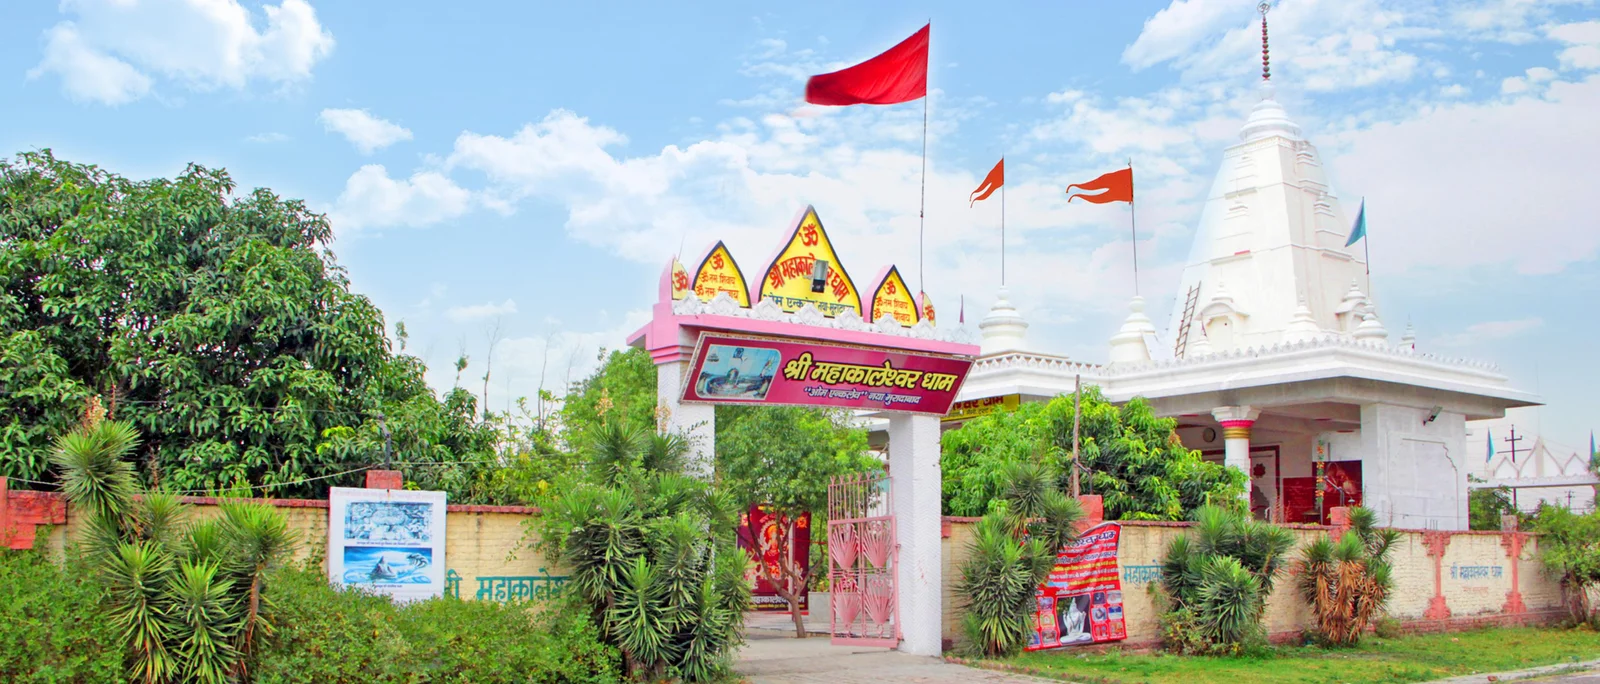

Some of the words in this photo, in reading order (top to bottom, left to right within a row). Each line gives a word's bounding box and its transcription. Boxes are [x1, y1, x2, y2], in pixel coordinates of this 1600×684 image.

[784, 352, 812, 380] श्री
[811, 361, 923, 389] महाकालेश्वर
[922, 373, 958, 392] धाम
